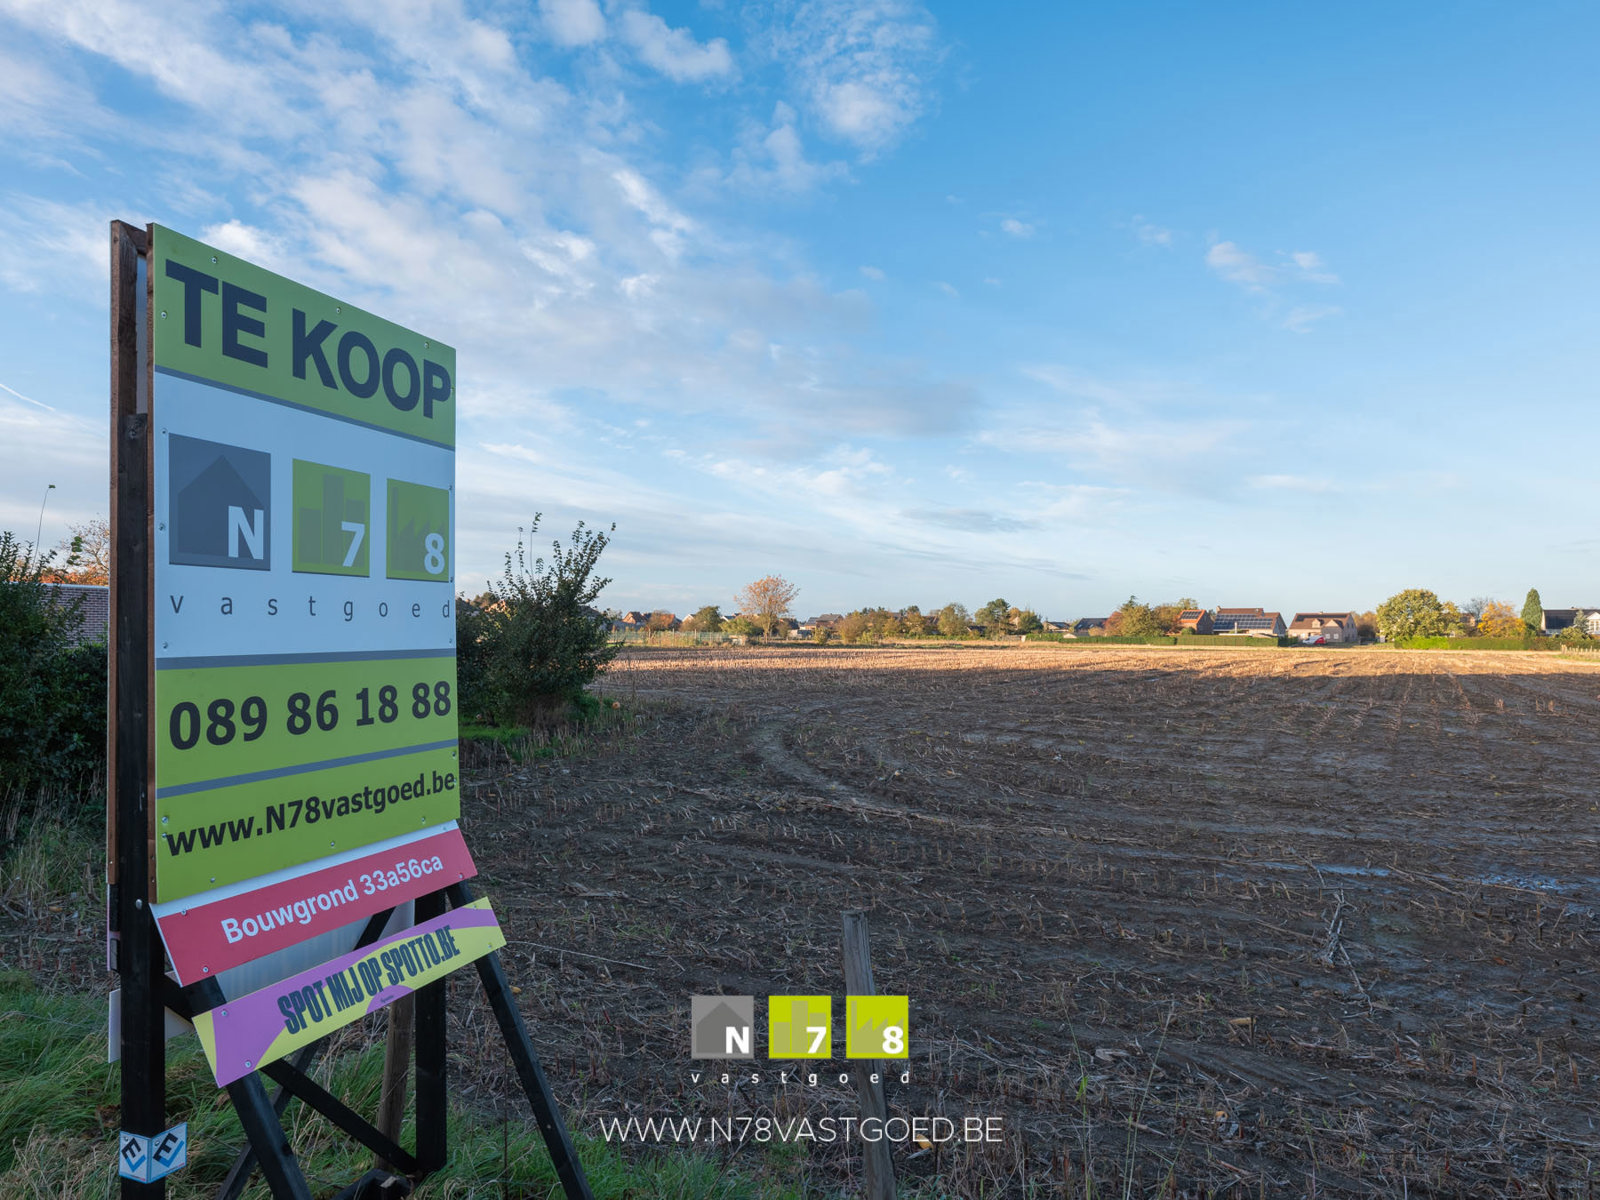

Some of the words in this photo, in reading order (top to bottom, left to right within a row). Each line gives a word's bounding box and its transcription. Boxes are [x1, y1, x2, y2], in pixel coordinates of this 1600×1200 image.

[165, 259, 268, 368] TE
[292, 308, 452, 419] KOOP
[169, 696, 268, 750] 089
[286, 690, 339, 735] 86
[356, 685, 398, 726] 18
[412, 681, 451, 718] 88
[166, 770, 456, 856] www.N78vastgoed.be
[221, 879, 359, 944] Bouwgrond
[360, 853, 444, 899] 33a56ca
[277, 979, 333, 1035] SPOT
[325, 966, 365, 1012] MIJ
[358, 957, 384, 997] OP
[380, 925, 461, 986] SPOTTO.BE
